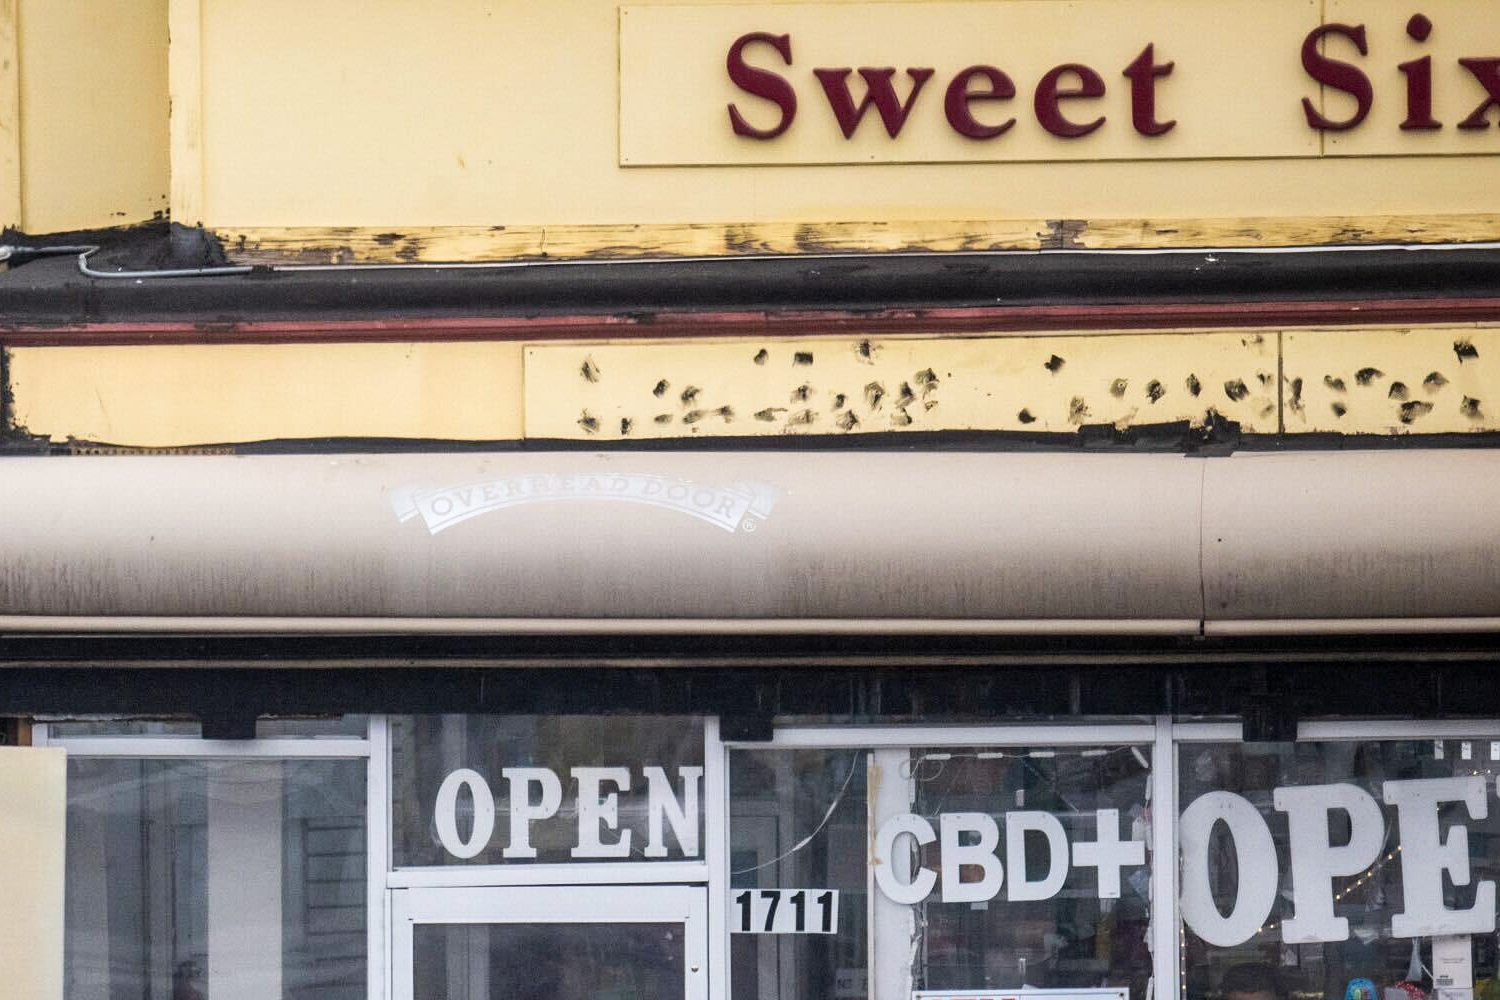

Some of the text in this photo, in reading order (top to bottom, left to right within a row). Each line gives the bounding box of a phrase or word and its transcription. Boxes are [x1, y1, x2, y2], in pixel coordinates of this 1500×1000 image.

[727, 31, 1177, 140] Sweet
[430, 475, 736, 519] OVERHEAD DOOR
[434, 765, 705, 860] OPEN
[874, 808, 1146, 905] CBD+
[1180, 774, 1500, 948] OPE
[735, 889, 833, 933] 1711
